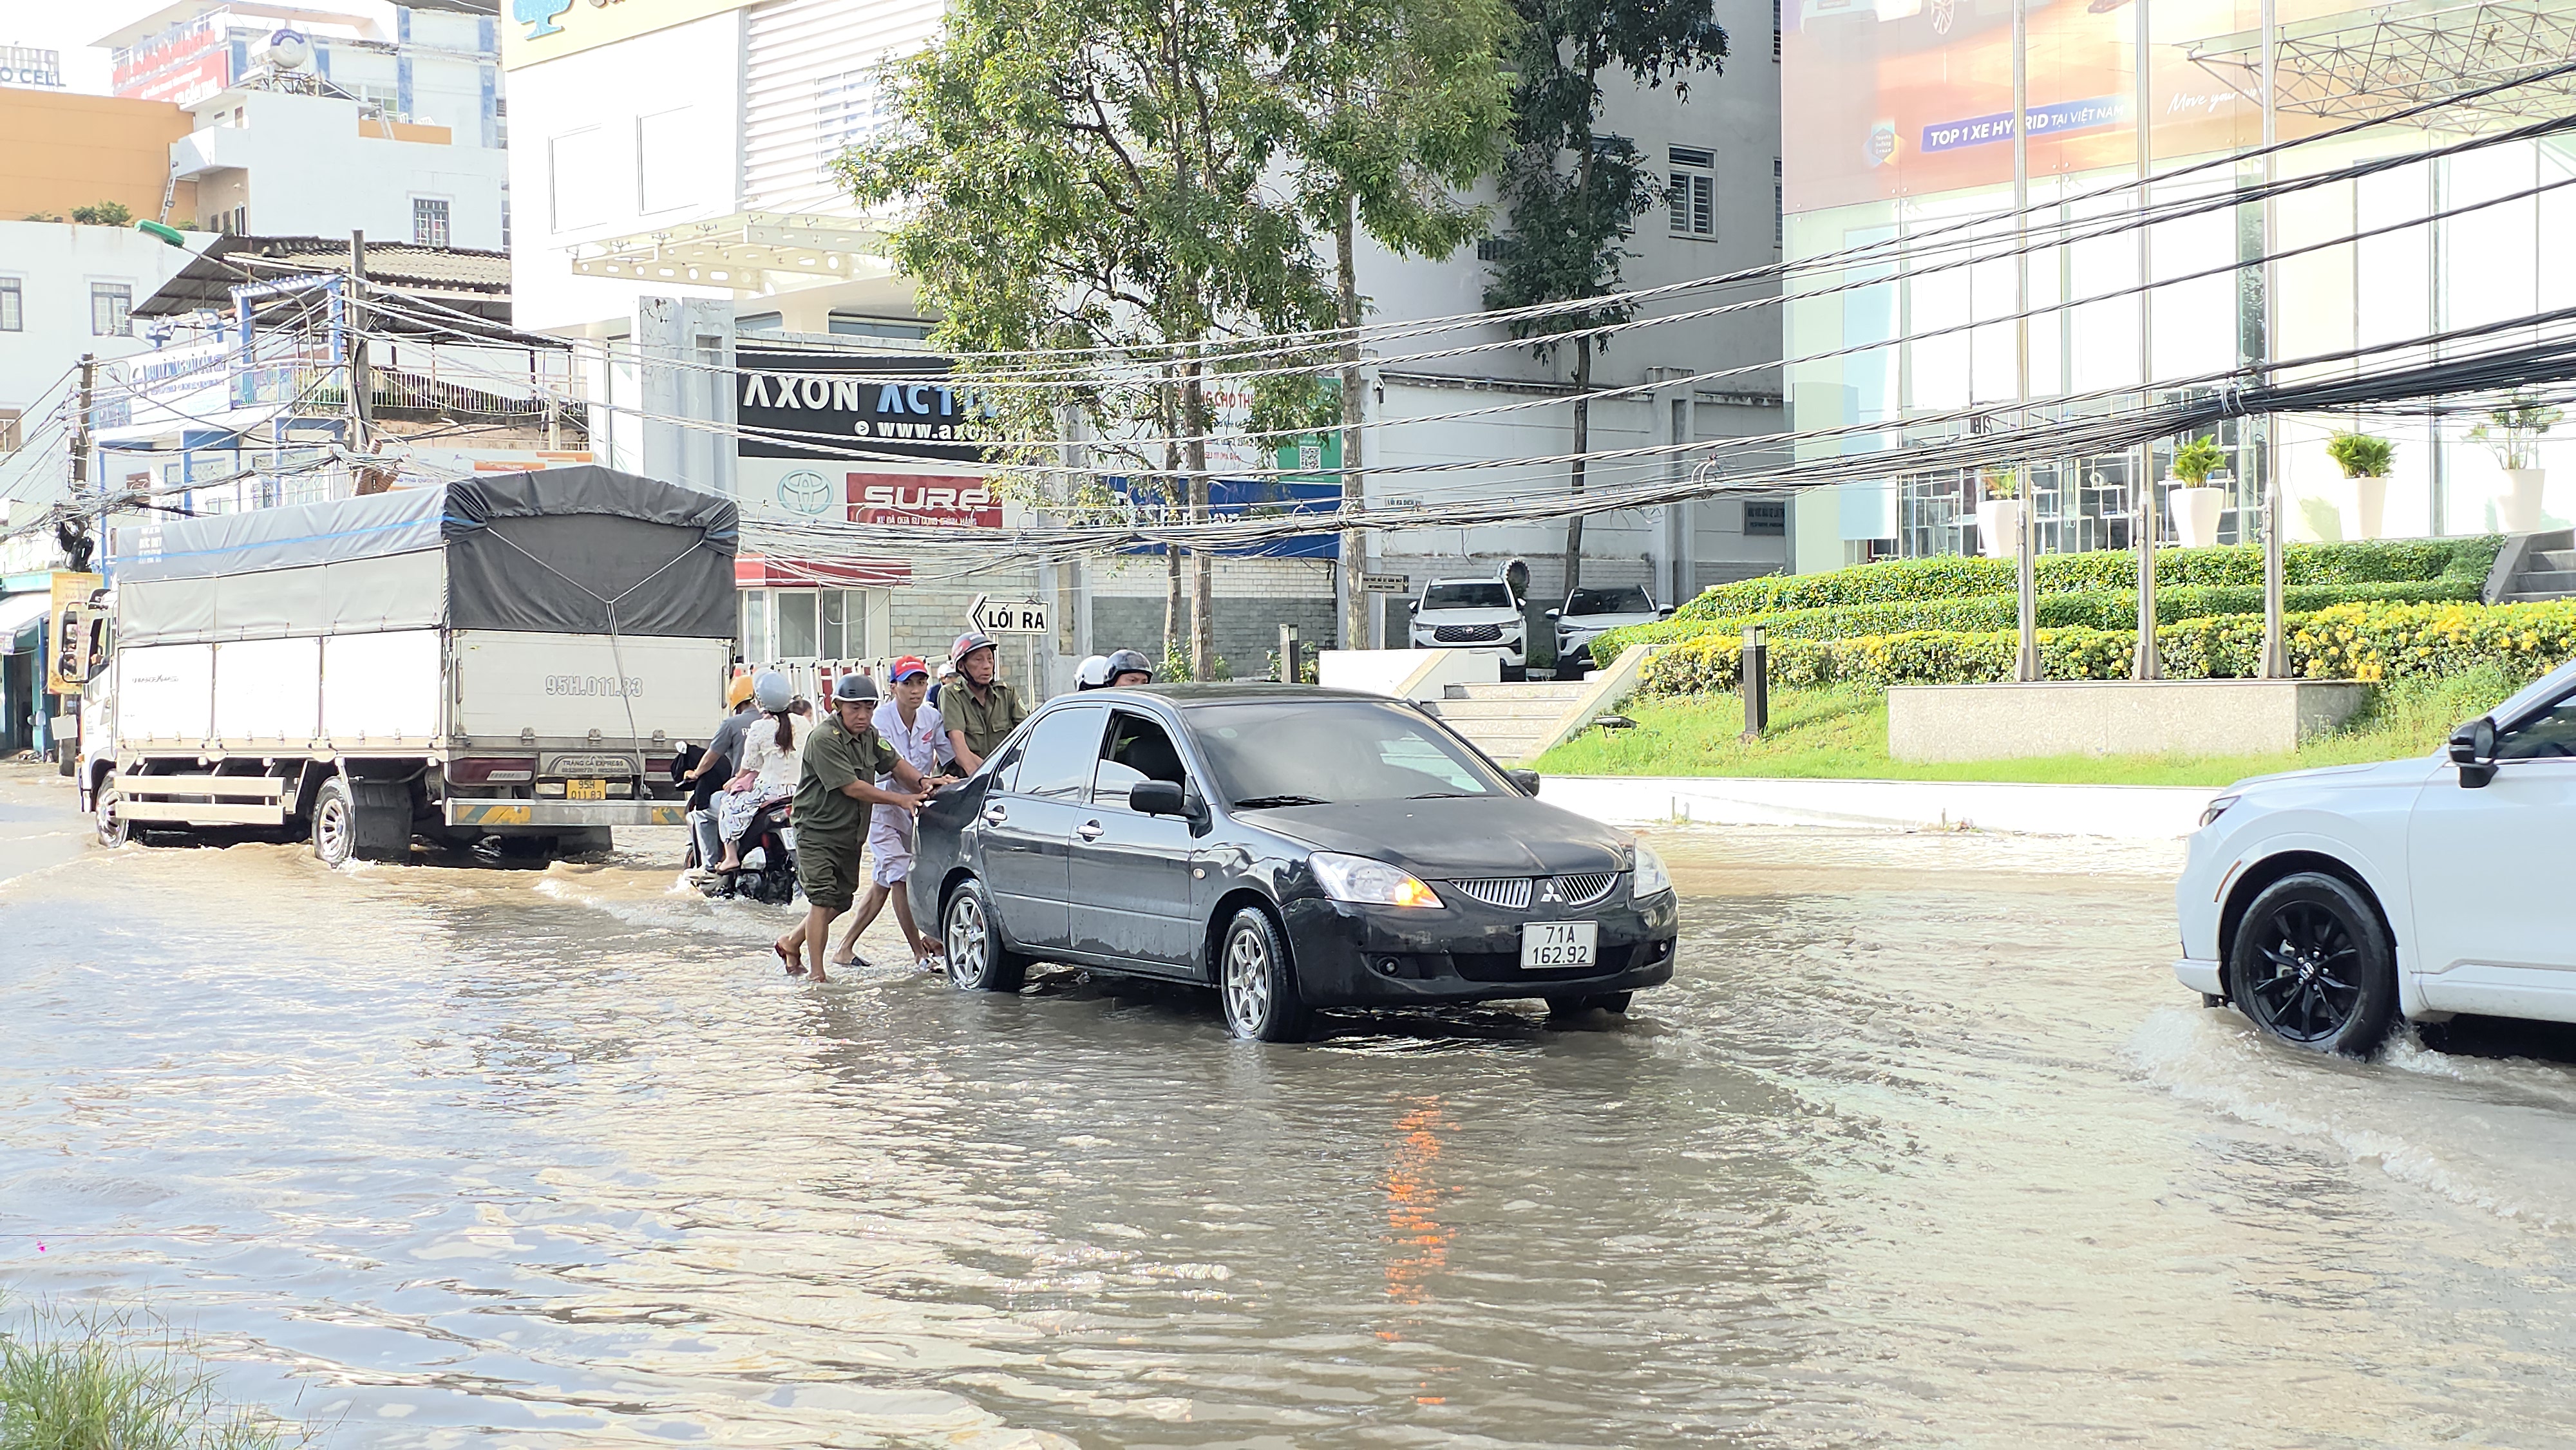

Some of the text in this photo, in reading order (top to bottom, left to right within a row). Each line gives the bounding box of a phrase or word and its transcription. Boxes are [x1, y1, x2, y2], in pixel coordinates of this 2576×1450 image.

[20, 68, 66, 87] CELL
[2166, 93, 2207, 115] Move
[2208, 91, 2238, 113] your
[1931, 104, 2125, 146] TOP 1 XE HYRID TẠI VIỆT NAM
[743, 374, 858, 411] AXON
[989, 603, 1045, 629] LỐI RA
[545, 675, 643, 697] 95H.011.83
[578, 780, 595, 789] 95H
[1546, 925, 1575, 944] 71A
[1533, 945, 1587, 965] 162.92
